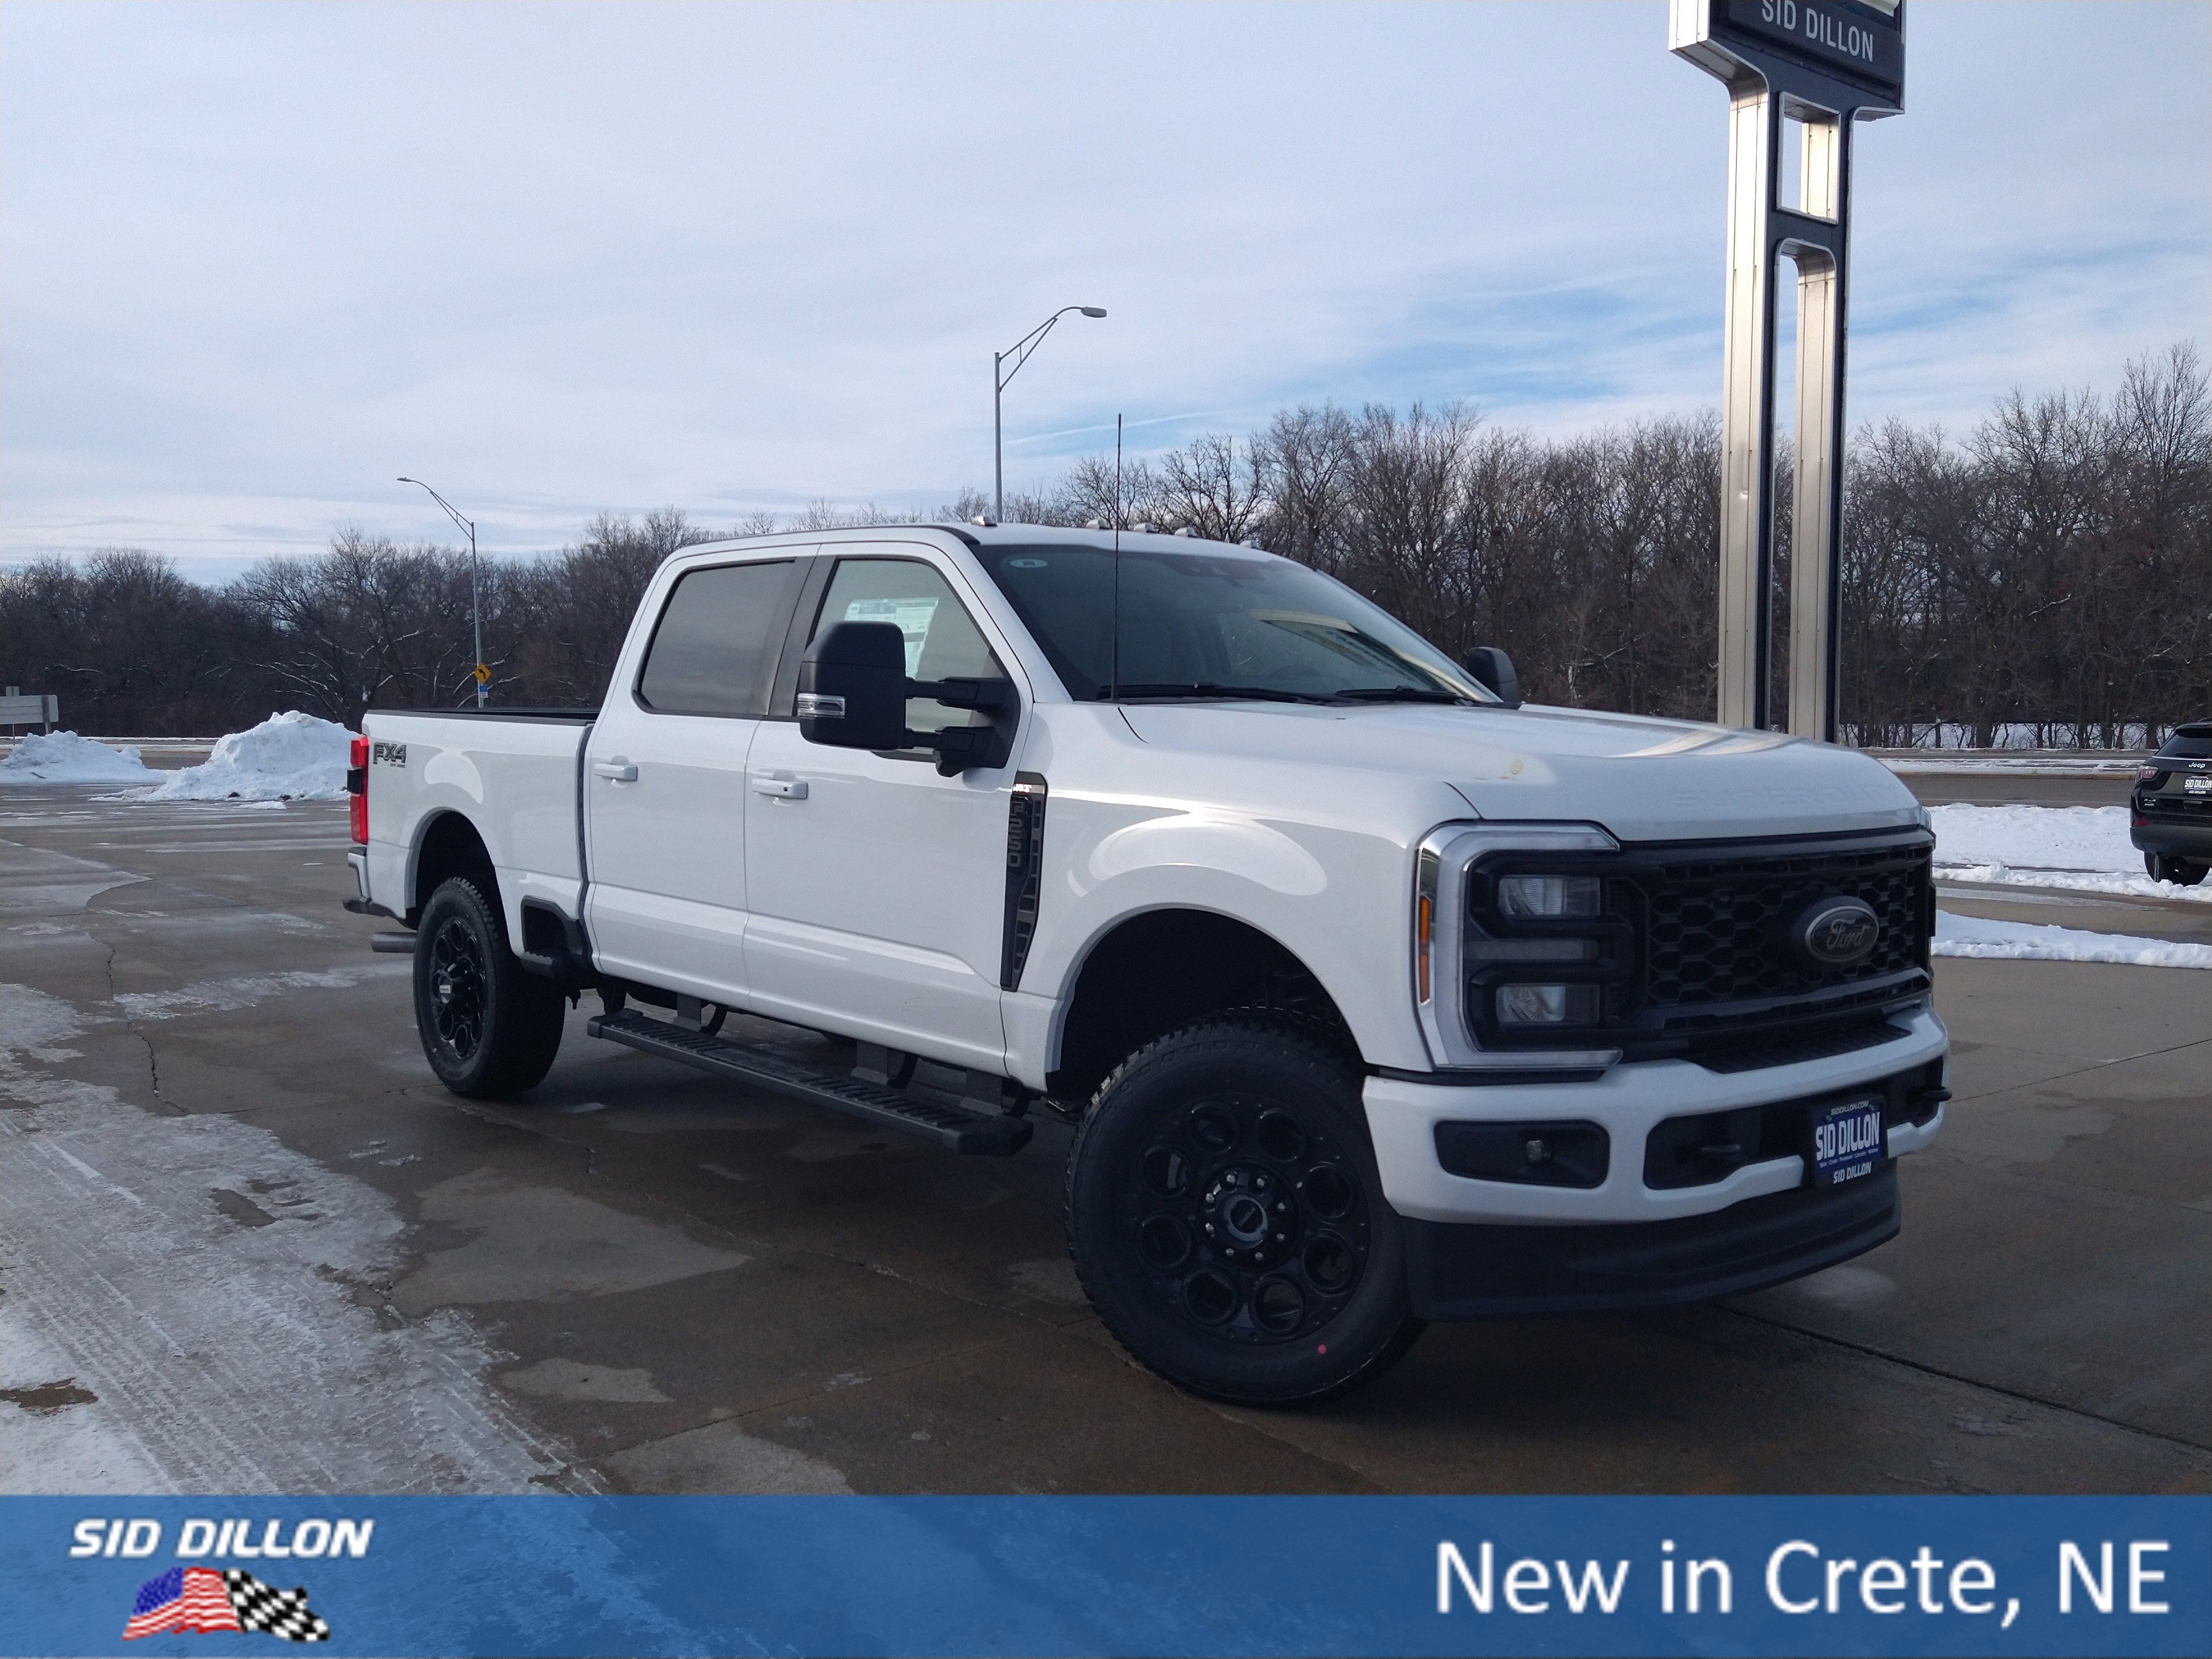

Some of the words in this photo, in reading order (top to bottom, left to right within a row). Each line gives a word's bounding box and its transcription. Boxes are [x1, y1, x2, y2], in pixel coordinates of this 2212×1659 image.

[1762, 0, 1797, 30] SID
[1806, 7, 1874, 62] DILLON
[373, 742, 407, 764] FX4
[2184, 779, 2194, 788] SID
[2194, 779, 2212, 789] DILLON
[1827, 919, 1871, 951] Ford
[1815, 1123, 1836, 1161] SID
[1838, 1112, 1880, 1155] DILLON
[1833, 1169, 1845, 1185] SID
[1846, 1161, 1872, 1181] DILLON
